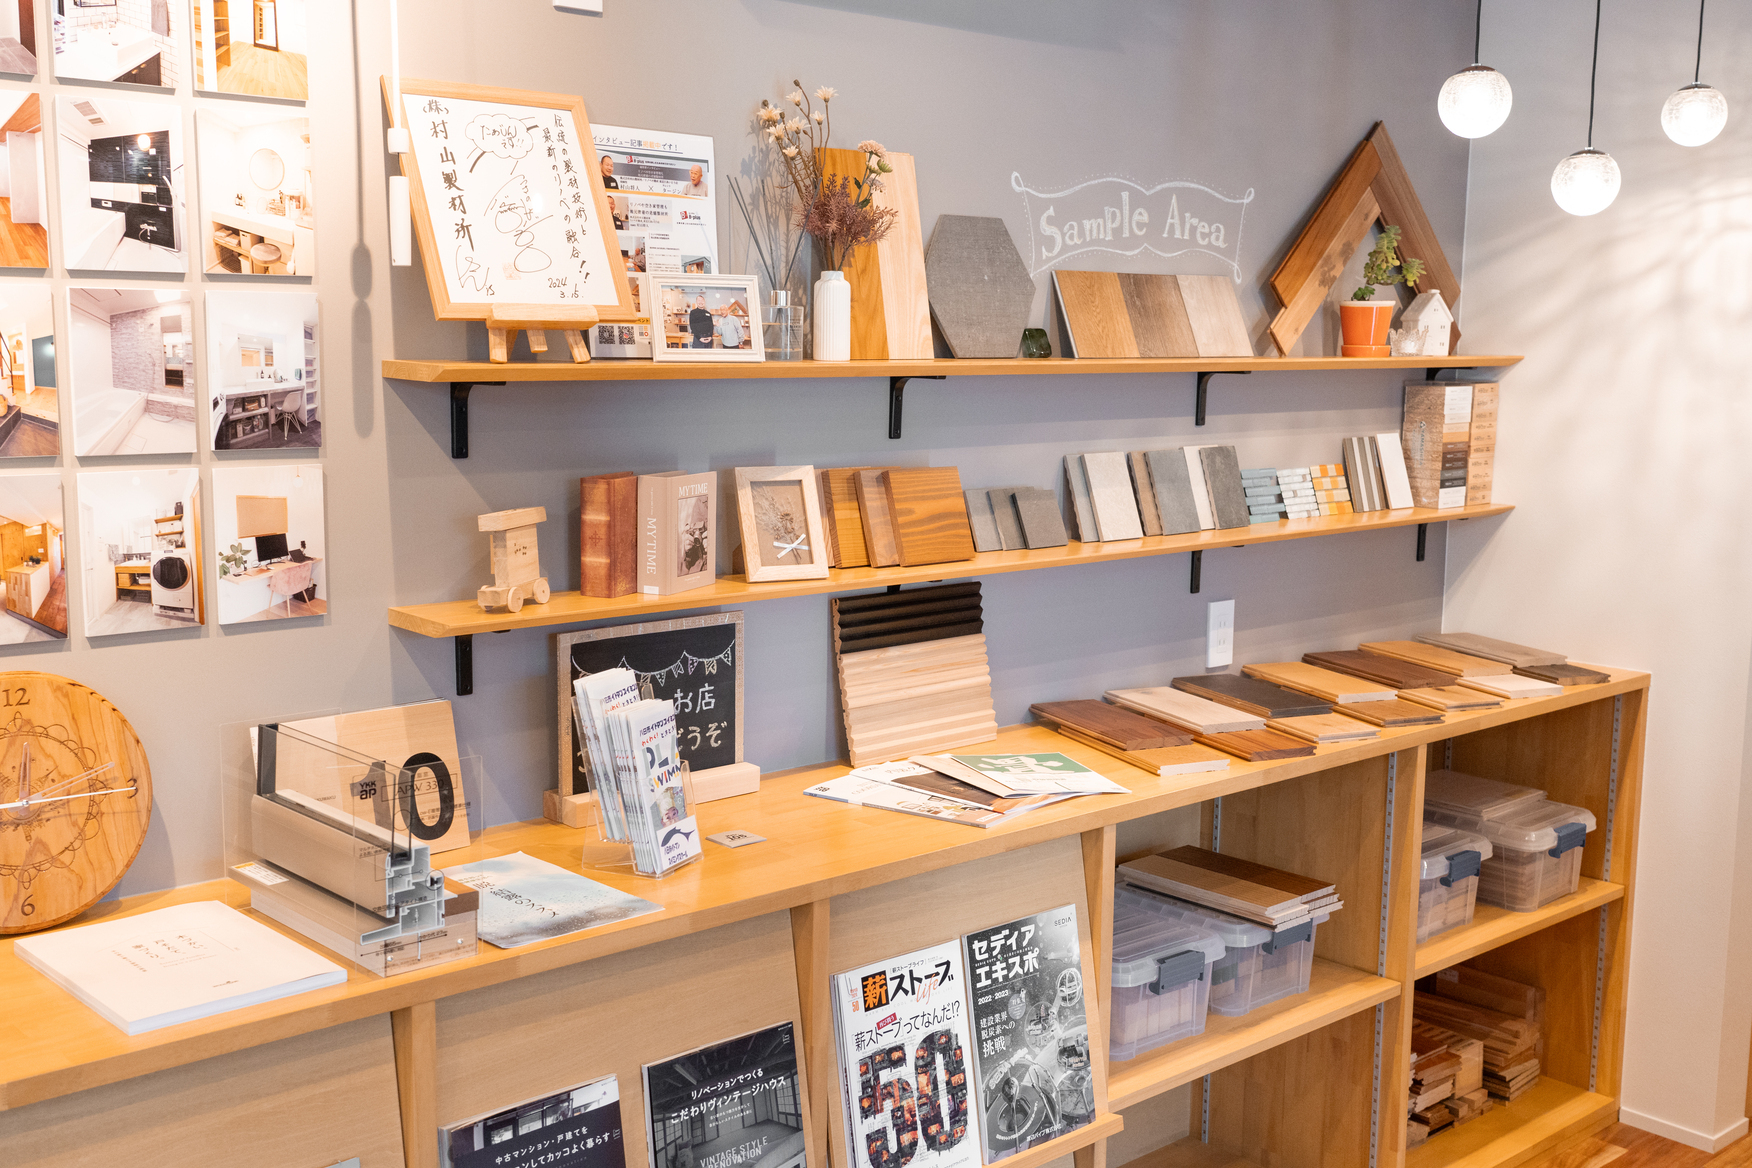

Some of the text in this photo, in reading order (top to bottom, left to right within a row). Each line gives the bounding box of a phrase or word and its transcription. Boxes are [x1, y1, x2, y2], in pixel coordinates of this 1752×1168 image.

[1039, 191, 1229, 260] Sample Area
[547, 276, 567, 289] 2024
[2, 687, 30, 707] 12
[127, 778, 138, 799] 3
[350, 752, 455, 841] 10
[359, 780, 377, 790] YKK
[21, 894, 36, 917] 6
[1054, 916, 1072, 927] SEDIA
[972, 923, 1036, 961] セディア
[976, 947, 1040, 989] エキスポ
[862, 960, 954, 1009] 薪ストーブ
[982, 1036, 1006, 1058] 挑戦
[670, 1076, 786, 1124] こだわりヴィンテージハウス
[691, 1068, 764, 1100] リノベーションでつくる
[700, 1136, 769, 1168] VINTAGE STYLE
